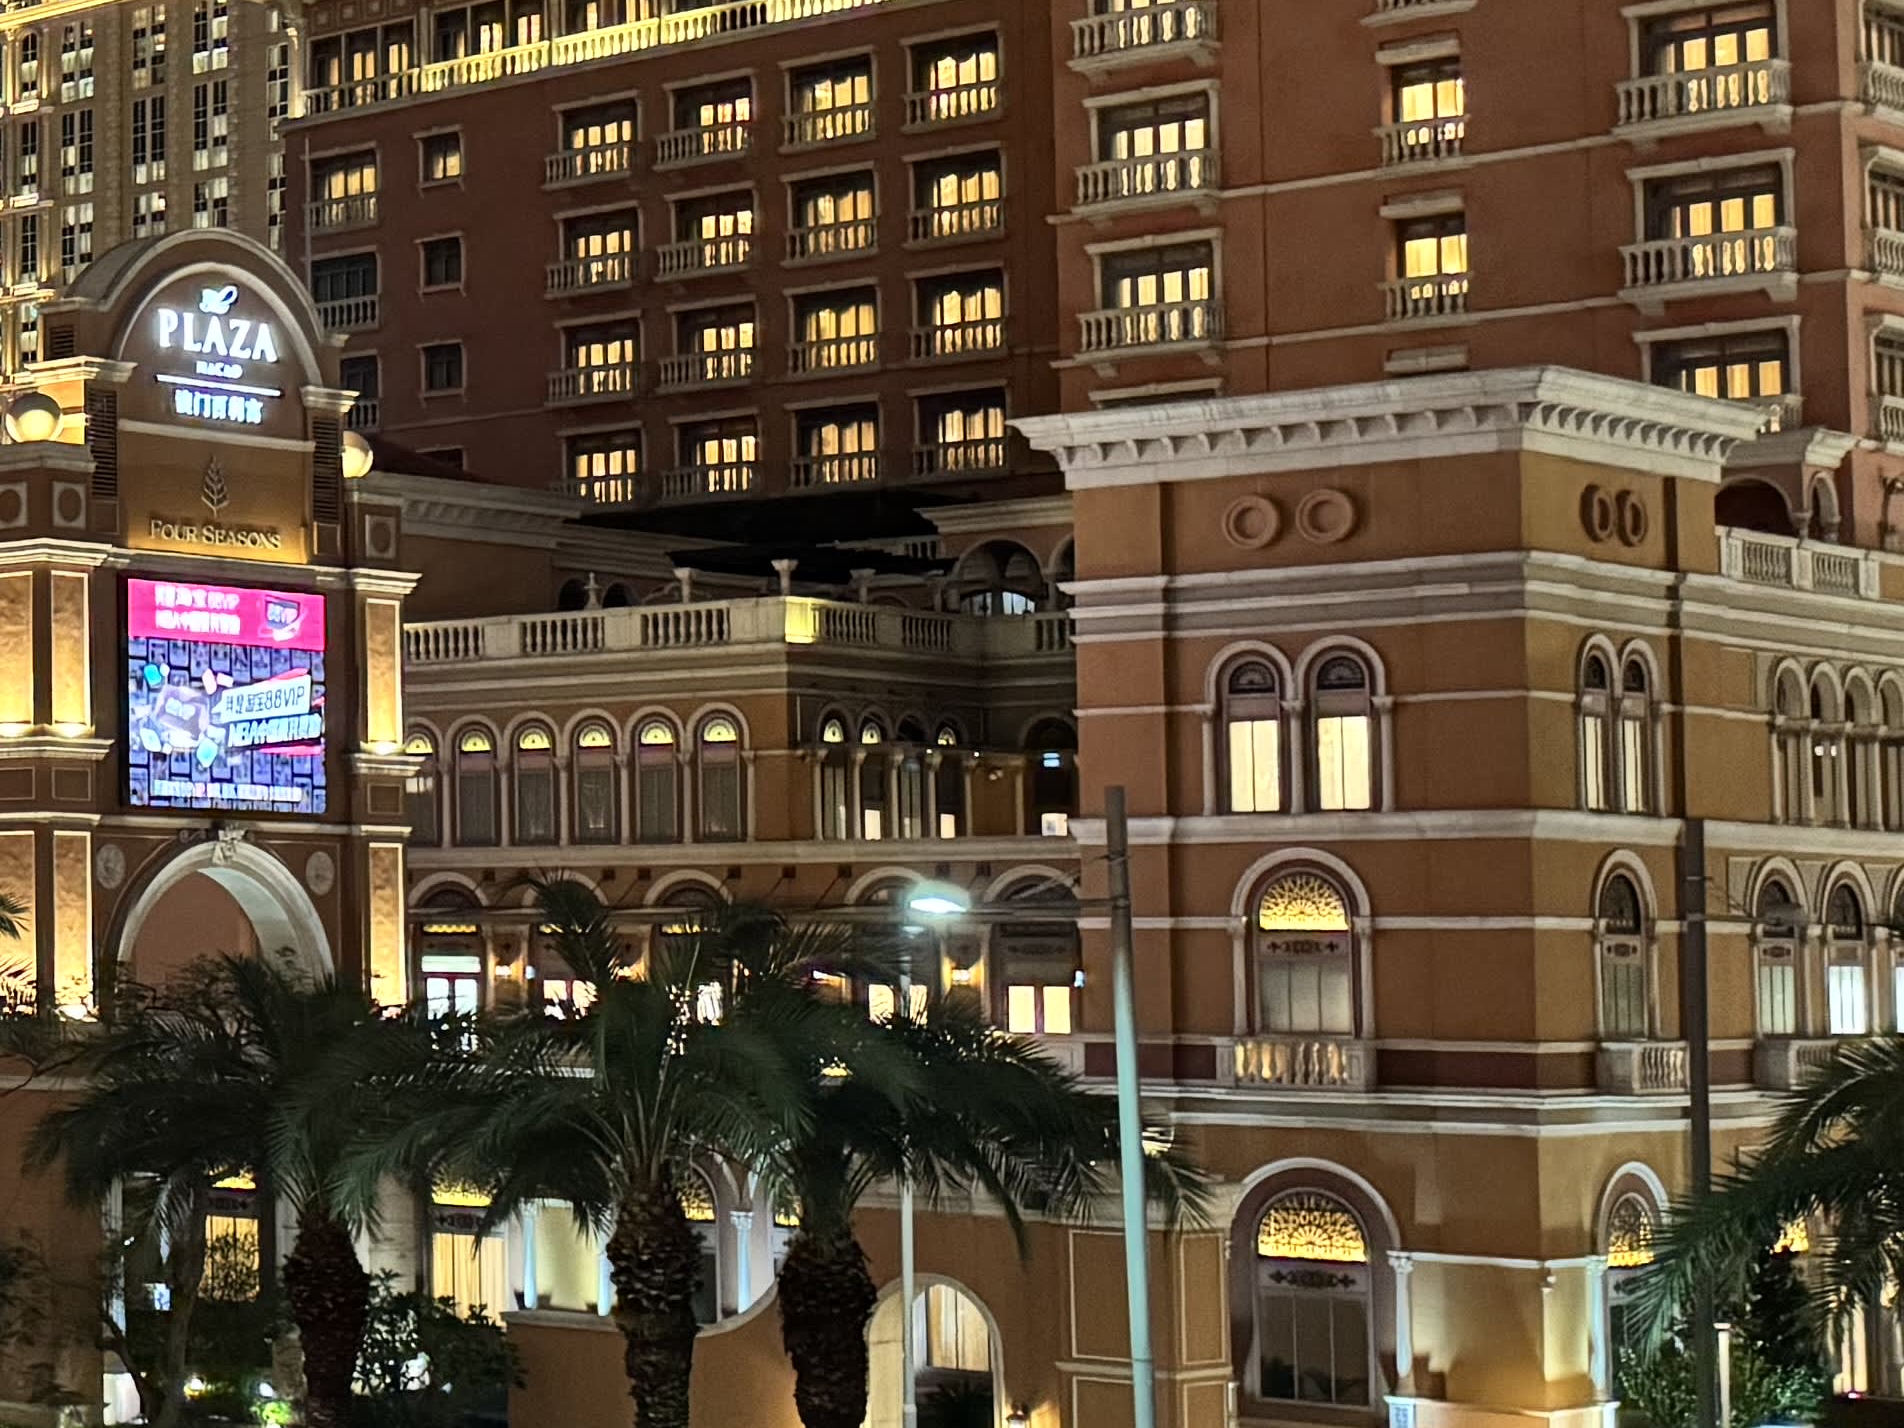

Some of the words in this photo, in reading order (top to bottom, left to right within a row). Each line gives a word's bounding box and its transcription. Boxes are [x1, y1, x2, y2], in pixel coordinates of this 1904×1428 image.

[157, 308, 279, 363] PLAZA
[150, 520, 198, 541] FOUR
[201, 524, 282, 549] SEASONS
